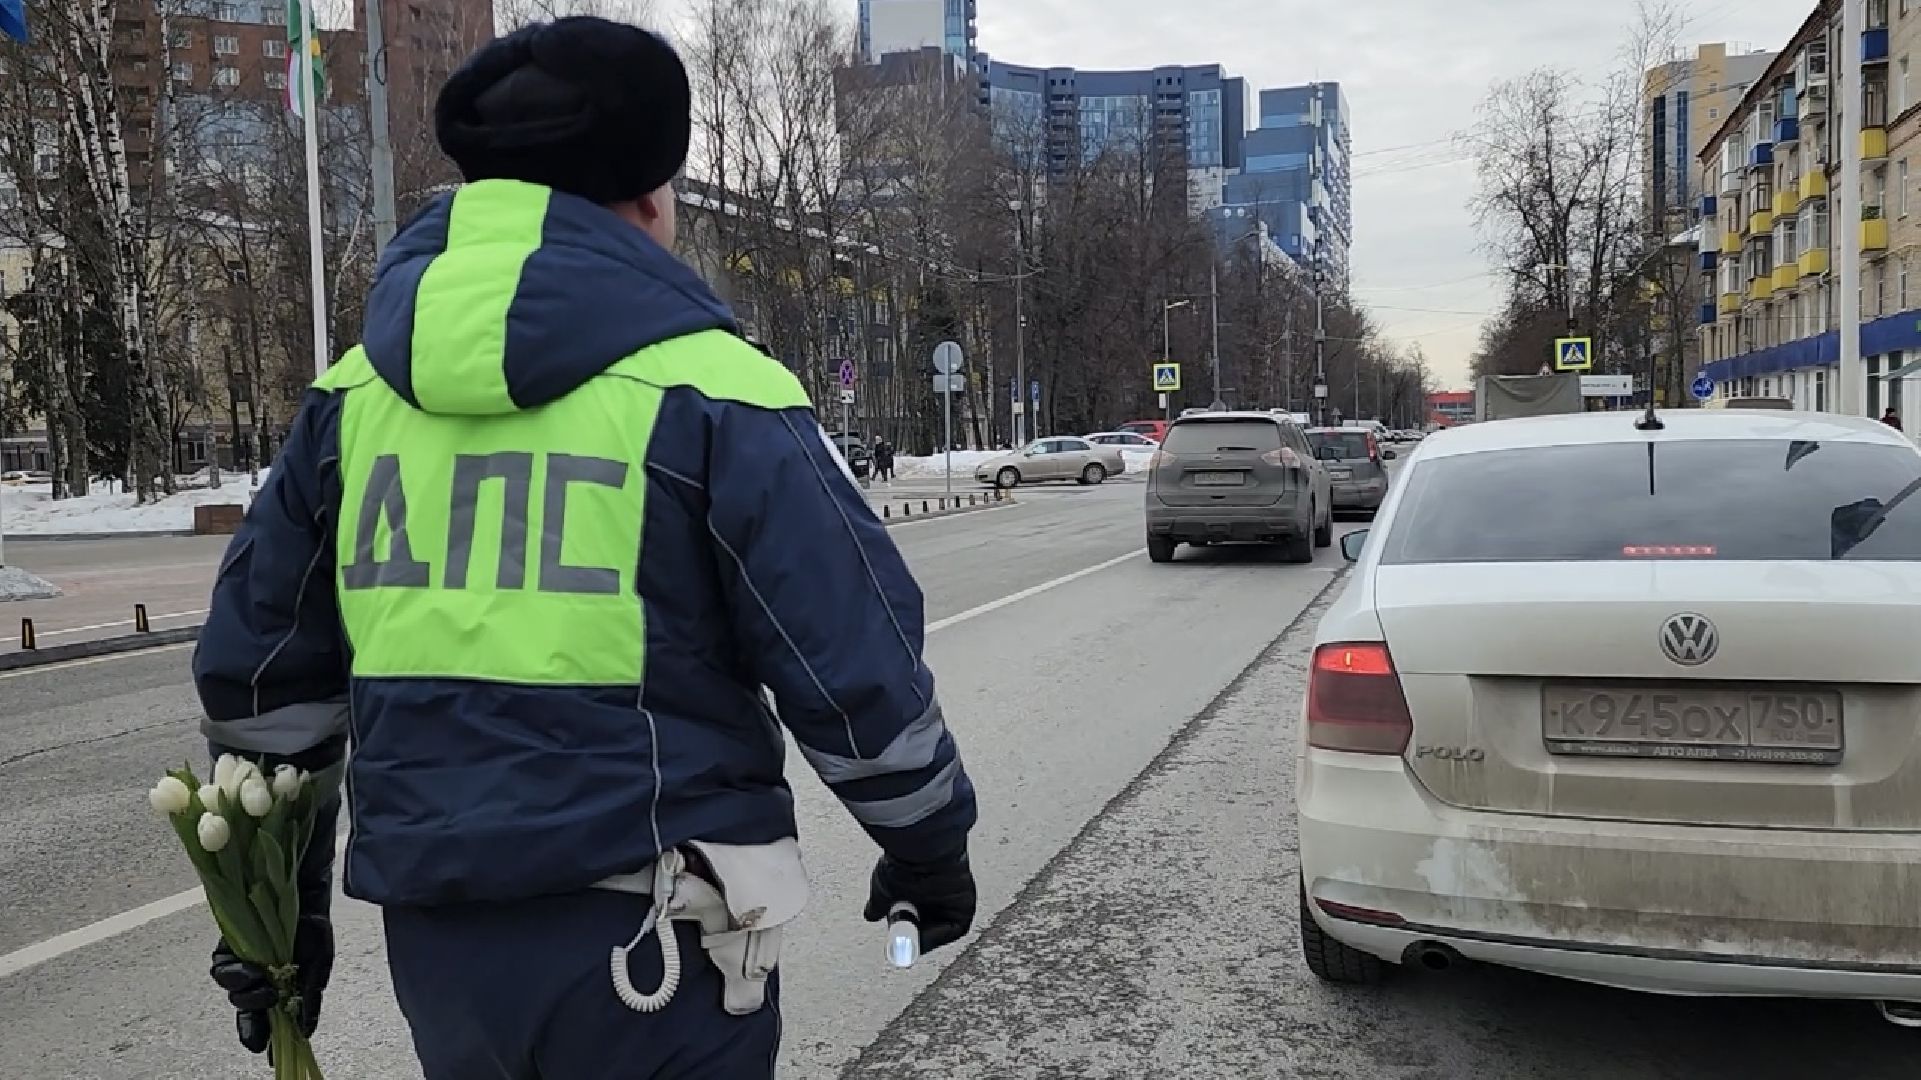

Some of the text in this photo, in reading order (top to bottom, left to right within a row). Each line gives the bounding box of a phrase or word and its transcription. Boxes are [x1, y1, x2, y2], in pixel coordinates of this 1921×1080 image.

[341, 451, 629, 596] ДПС
[1559, 693, 1824, 740] К945ОХ 750
[1770, 729, 1807, 742] RUS
[1416, 745, 1485, 762] POLO
